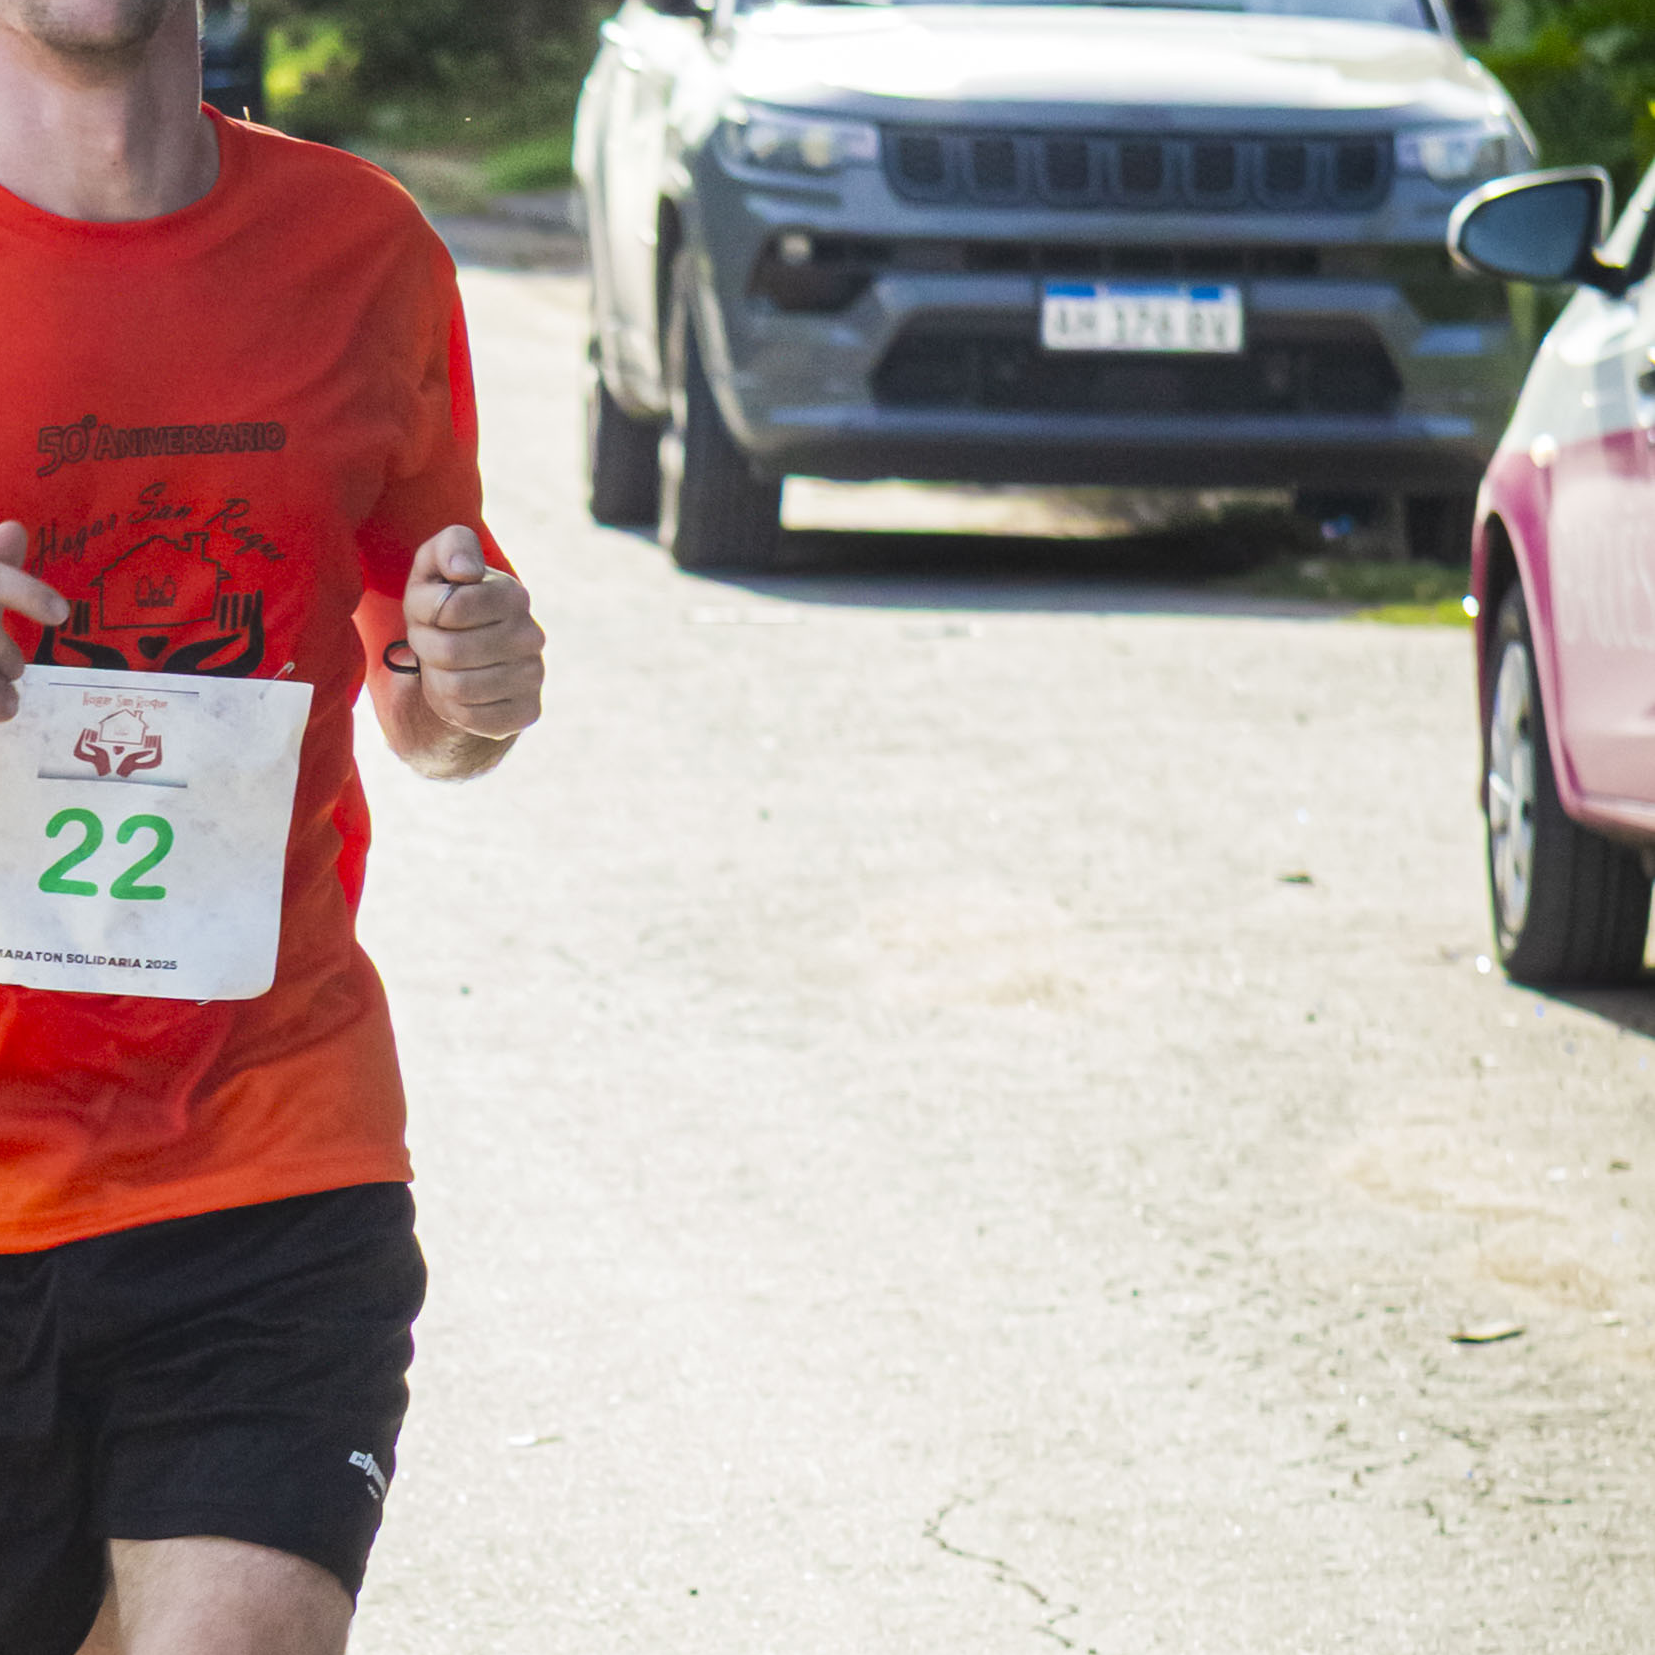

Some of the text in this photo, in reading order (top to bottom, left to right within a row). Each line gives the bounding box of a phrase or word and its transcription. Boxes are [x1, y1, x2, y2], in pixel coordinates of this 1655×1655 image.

[30, 514, 118, 579] Hogar
[128, 482, 193, 524] San
[37, 807, 175, 900] 22
[66, 952, 142, 969] SOLIDARIA
[145, 959, 178, 970] 2025
